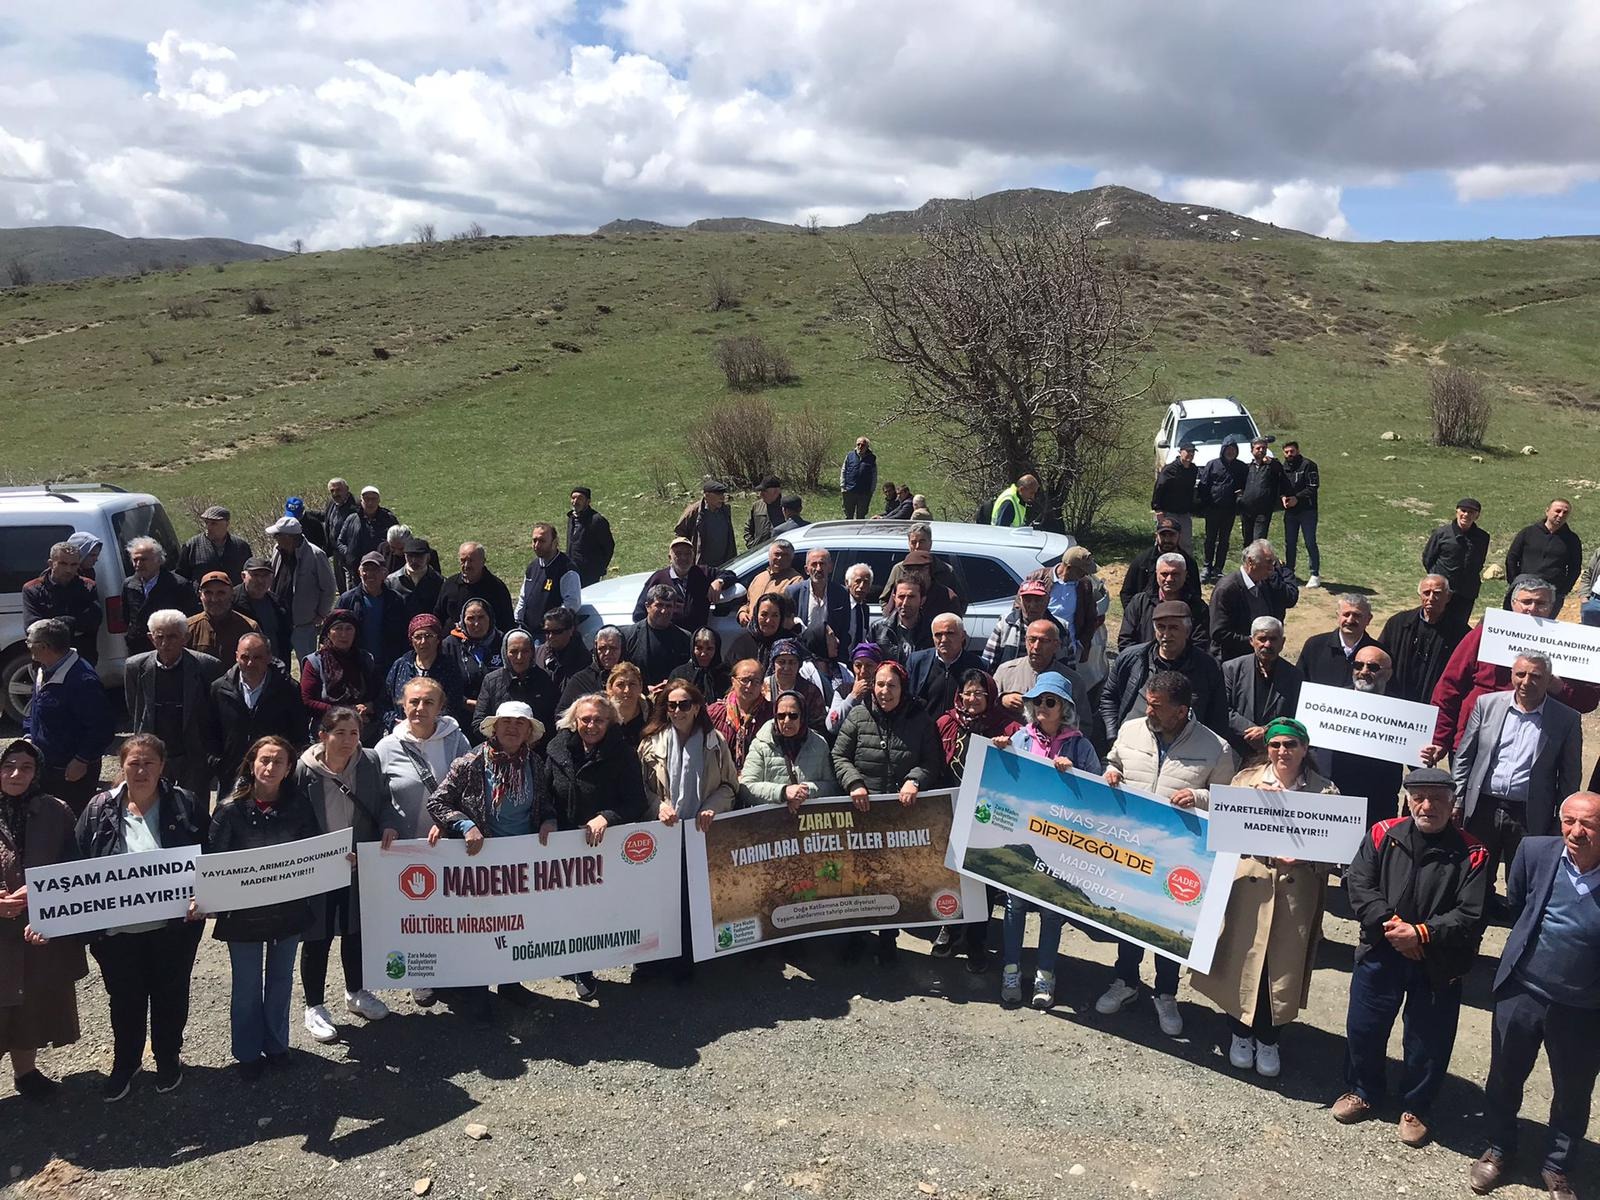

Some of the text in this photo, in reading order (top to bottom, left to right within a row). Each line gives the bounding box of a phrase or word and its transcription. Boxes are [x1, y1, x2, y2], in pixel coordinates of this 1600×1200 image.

[1487, 626, 1538, 642] SUYUMUZU
[1549, 651, 1590, 665] HAYIR!!!
[1305, 702, 1428, 733] DOĞAMIZA DOKUNMA!!!
[1319, 721, 1407, 745] MADENE HAYIR!!!
[798, 811, 854, 832] ZARA'DA
[1049, 804, 1141, 846] SİVAS ZARA
[1214, 802, 1361, 825] ZİYARETLERİMİZE DOKUNMA!!!
[1244, 822, 1328, 837] MADENE HAYIR!!!
[730, 828, 932, 867] YARINLARA GÜZEL İZLER BIRAK!
[1029, 818, 1154, 875] DİPSİZGÖL'DE
[201, 846, 348, 878] YAYLAMIZA, ARIMIZA DOKUNMA!!!
[1059, 853, 1105, 877] MADEN
[33, 860, 196, 893] YAŞAM ALANINDA
[240, 867, 315, 887] MADENE HAYIR!!!
[443, 854, 604, 897] MADENE HAYIR!
[1033, 858, 1118, 899] İSTEMİYORUZ
[1171, 872, 1199, 889] ZADEF
[39, 886, 195, 920] MADENE HAYIR!!!
[400, 913, 525, 934] KÜLTÜREL MİRASIMIZA
[494, 935, 508, 950] VE
[512, 929, 641, 961] DOĞAMIZA DOKUNMAYIN!
